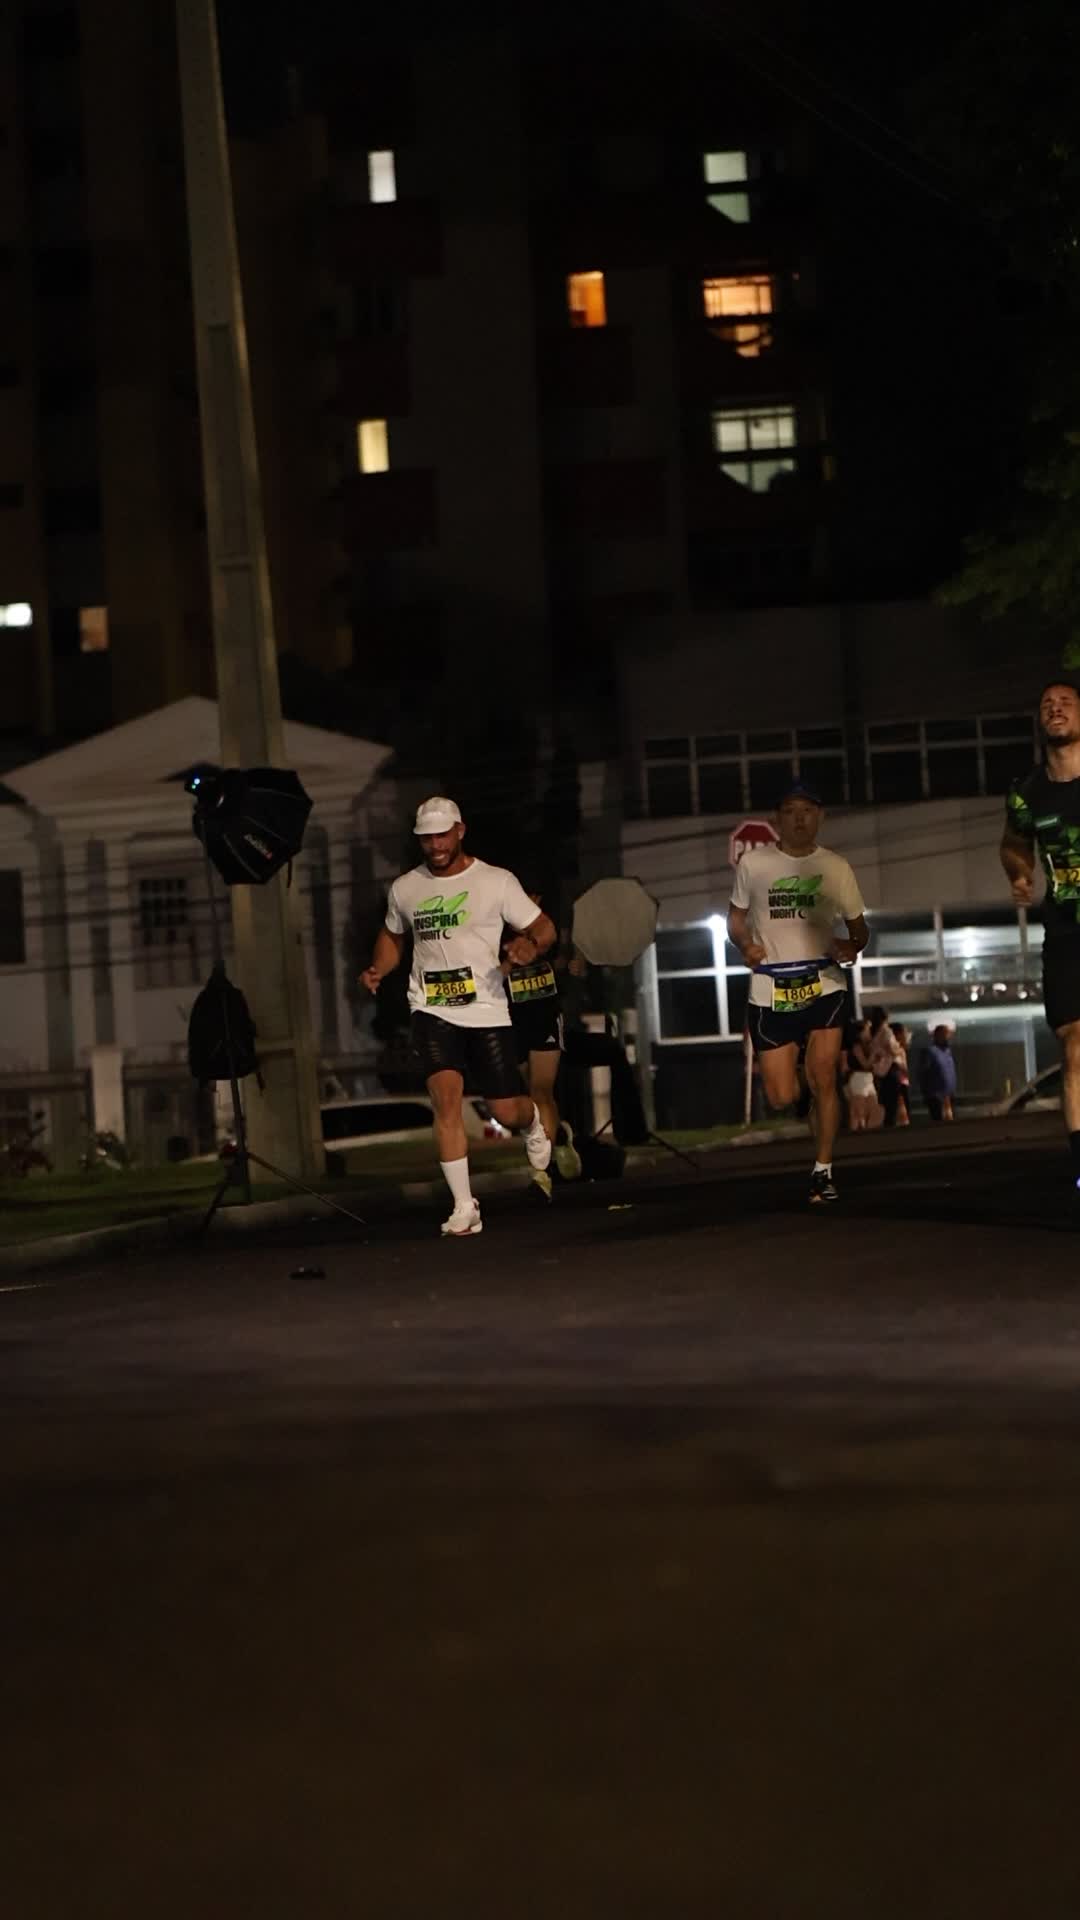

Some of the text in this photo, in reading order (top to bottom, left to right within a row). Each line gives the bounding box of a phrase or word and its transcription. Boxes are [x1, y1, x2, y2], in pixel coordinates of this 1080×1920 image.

[768, 895, 816, 908] INSPIRA
[770, 908, 796, 920] NIGHT
[414, 914, 459, 930] INSPIRA
[434, 982, 467, 996] 2868
[783, 985, 814, 1002] 1804
